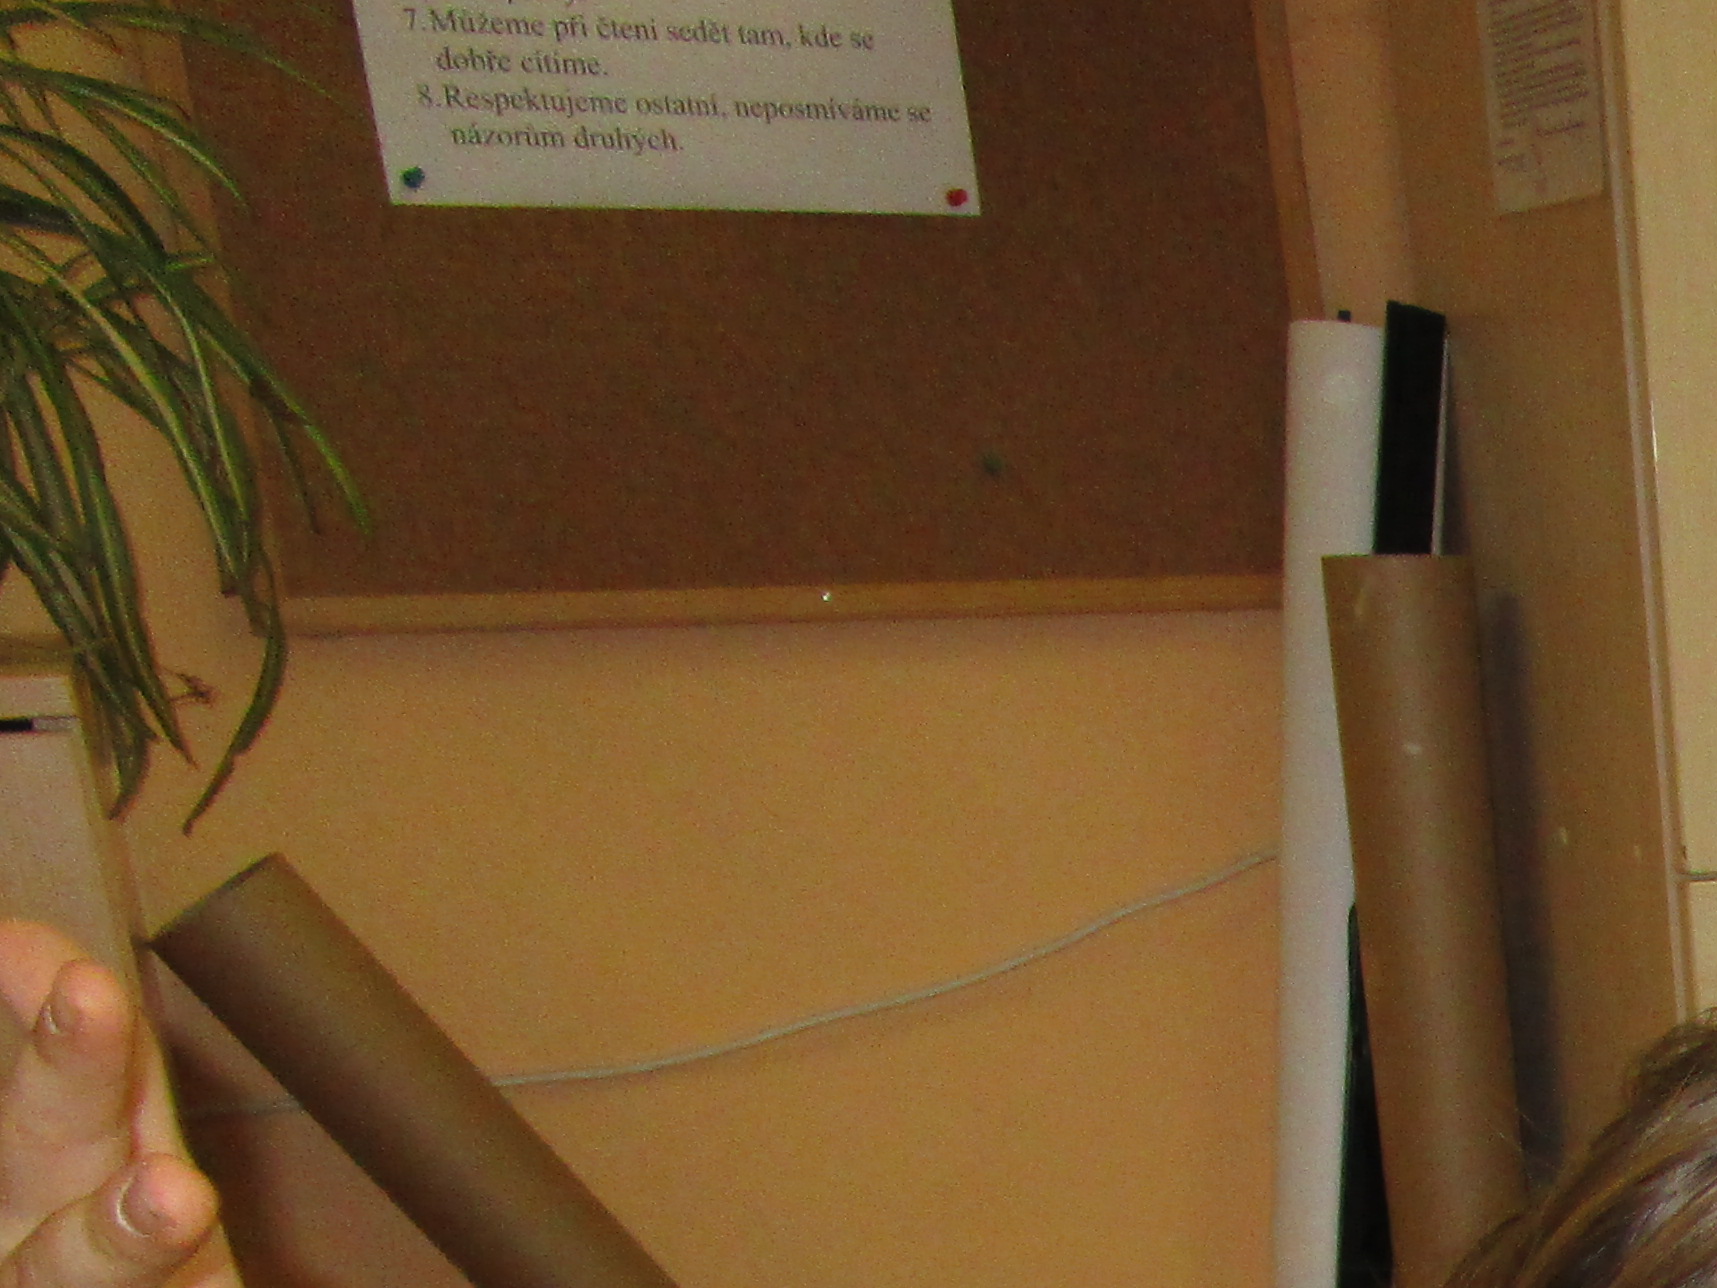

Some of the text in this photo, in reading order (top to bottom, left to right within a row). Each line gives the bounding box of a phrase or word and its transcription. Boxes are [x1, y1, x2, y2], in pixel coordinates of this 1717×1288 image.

[553, 13, 588, 43] při
[666, 19, 731, 44] sedět
[738, 24, 793, 50] tam,
[798, 22, 843, 49] kde
[849, 31, 874, 50] se
[435, 46, 510, 73] dobře
[636, 94, 728, 119] ostatní,
[735, 96, 901, 125] neposmíváme
[907, 104, 932, 123] se
[451, 122, 684, 155] názorům druhých.
